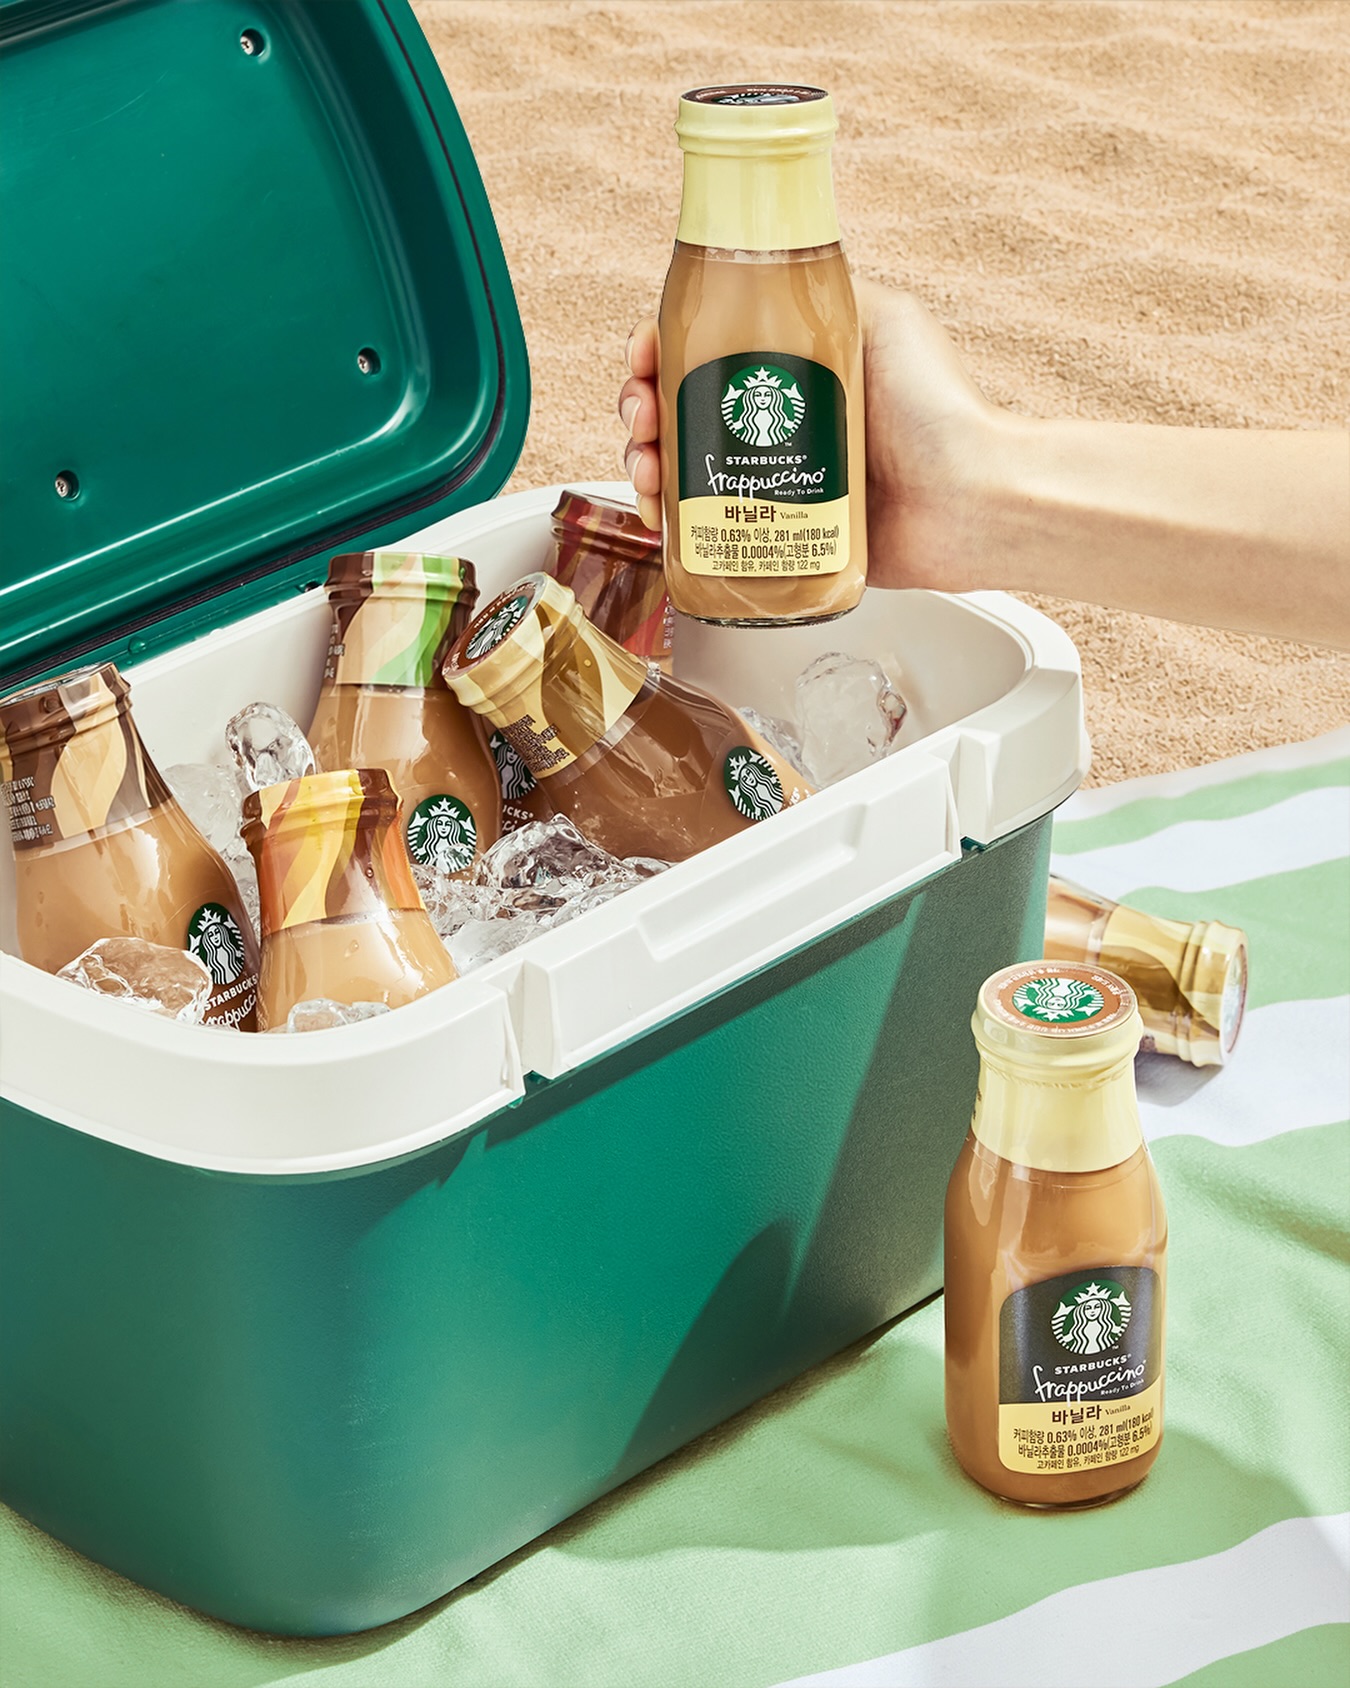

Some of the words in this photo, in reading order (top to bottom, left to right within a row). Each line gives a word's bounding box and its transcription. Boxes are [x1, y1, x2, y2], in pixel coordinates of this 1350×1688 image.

[704, 453, 826, 504] frappuccino
[774, 489, 795, 497] Ready
[806, 487, 825, 495] Drink
[725, 505, 776, 523] 바닐라
[780, 511, 809, 519] Vanilla
[720, 528, 751, 543] 0.63%
[774, 529, 790, 542] 281
[796, 559, 808, 570] 122
[809, 560, 821, 571] mg
[1032, 1360, 1145, 1408] frappuccino
[1052, 1405, 1102, 1425] 바닐라
[1105, 1404, 1131, 1416] Vanilla
[1047, 1430, 1077, 1444] 0.63%
[1099, 1424, 1114, 1437] 281
